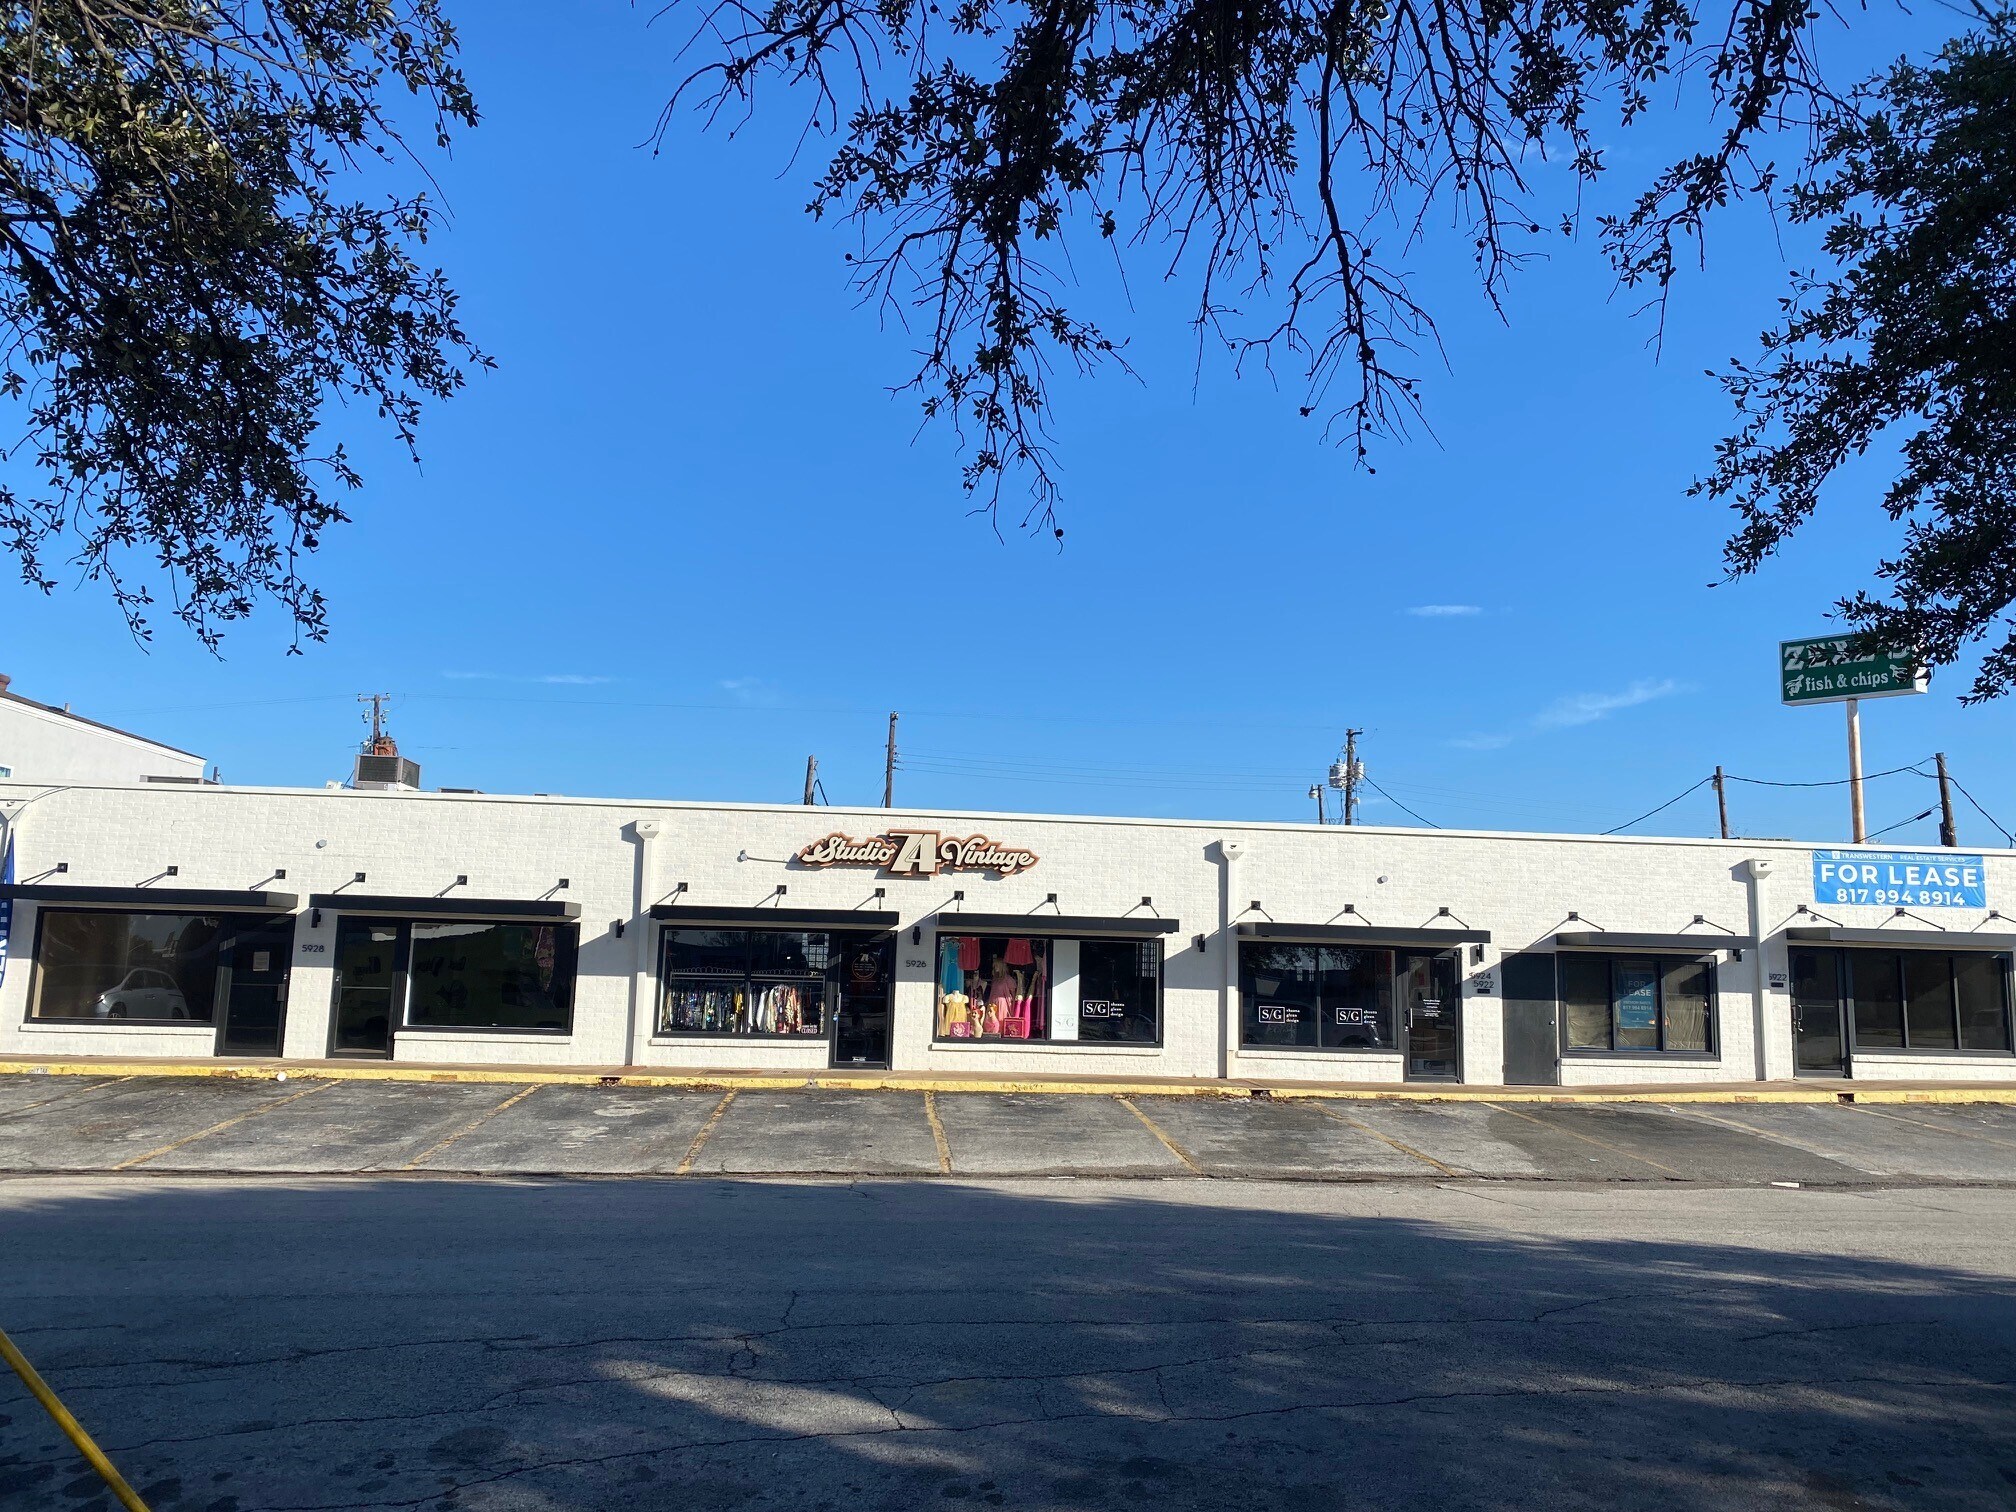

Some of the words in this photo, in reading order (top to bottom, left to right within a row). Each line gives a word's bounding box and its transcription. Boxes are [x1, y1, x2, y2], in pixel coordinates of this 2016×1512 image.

[1805, 675, 1834, 692] fish
[1836, 673, 1848, 688] &
[1850, 670, 1889, 688] chips
[801, 836, 897, 863] Studio
[888, 832, 941, 873] 74
[940, 837, 1035, 873] Vintage
[1841, 852, 1894, 861] TRANSWESTERN
[1821, 863, 1879, 884] FOR
[1888, 865, 1978, 888] LEASE
[1836, 888, 1869, 903] 817
[1874, 889, 1914, 905] 994
[1919, 890, 1966, 906] 8914
[301, 944, 325, 953] 5928
[905, 960, 927, 968] 5926
[1469, 972, 1491, 980] 5924
[1473, 980, 1495, 989] 5922
[1628, 980, 1646, 988] FOR
[1623, 989, 1652, 997] LEASE
[1085, 1002, 1107, 1014] S/G
[1261, 1009, 1282, 1020] S/G
[1339, 1010, 1360, 1022] S/G
